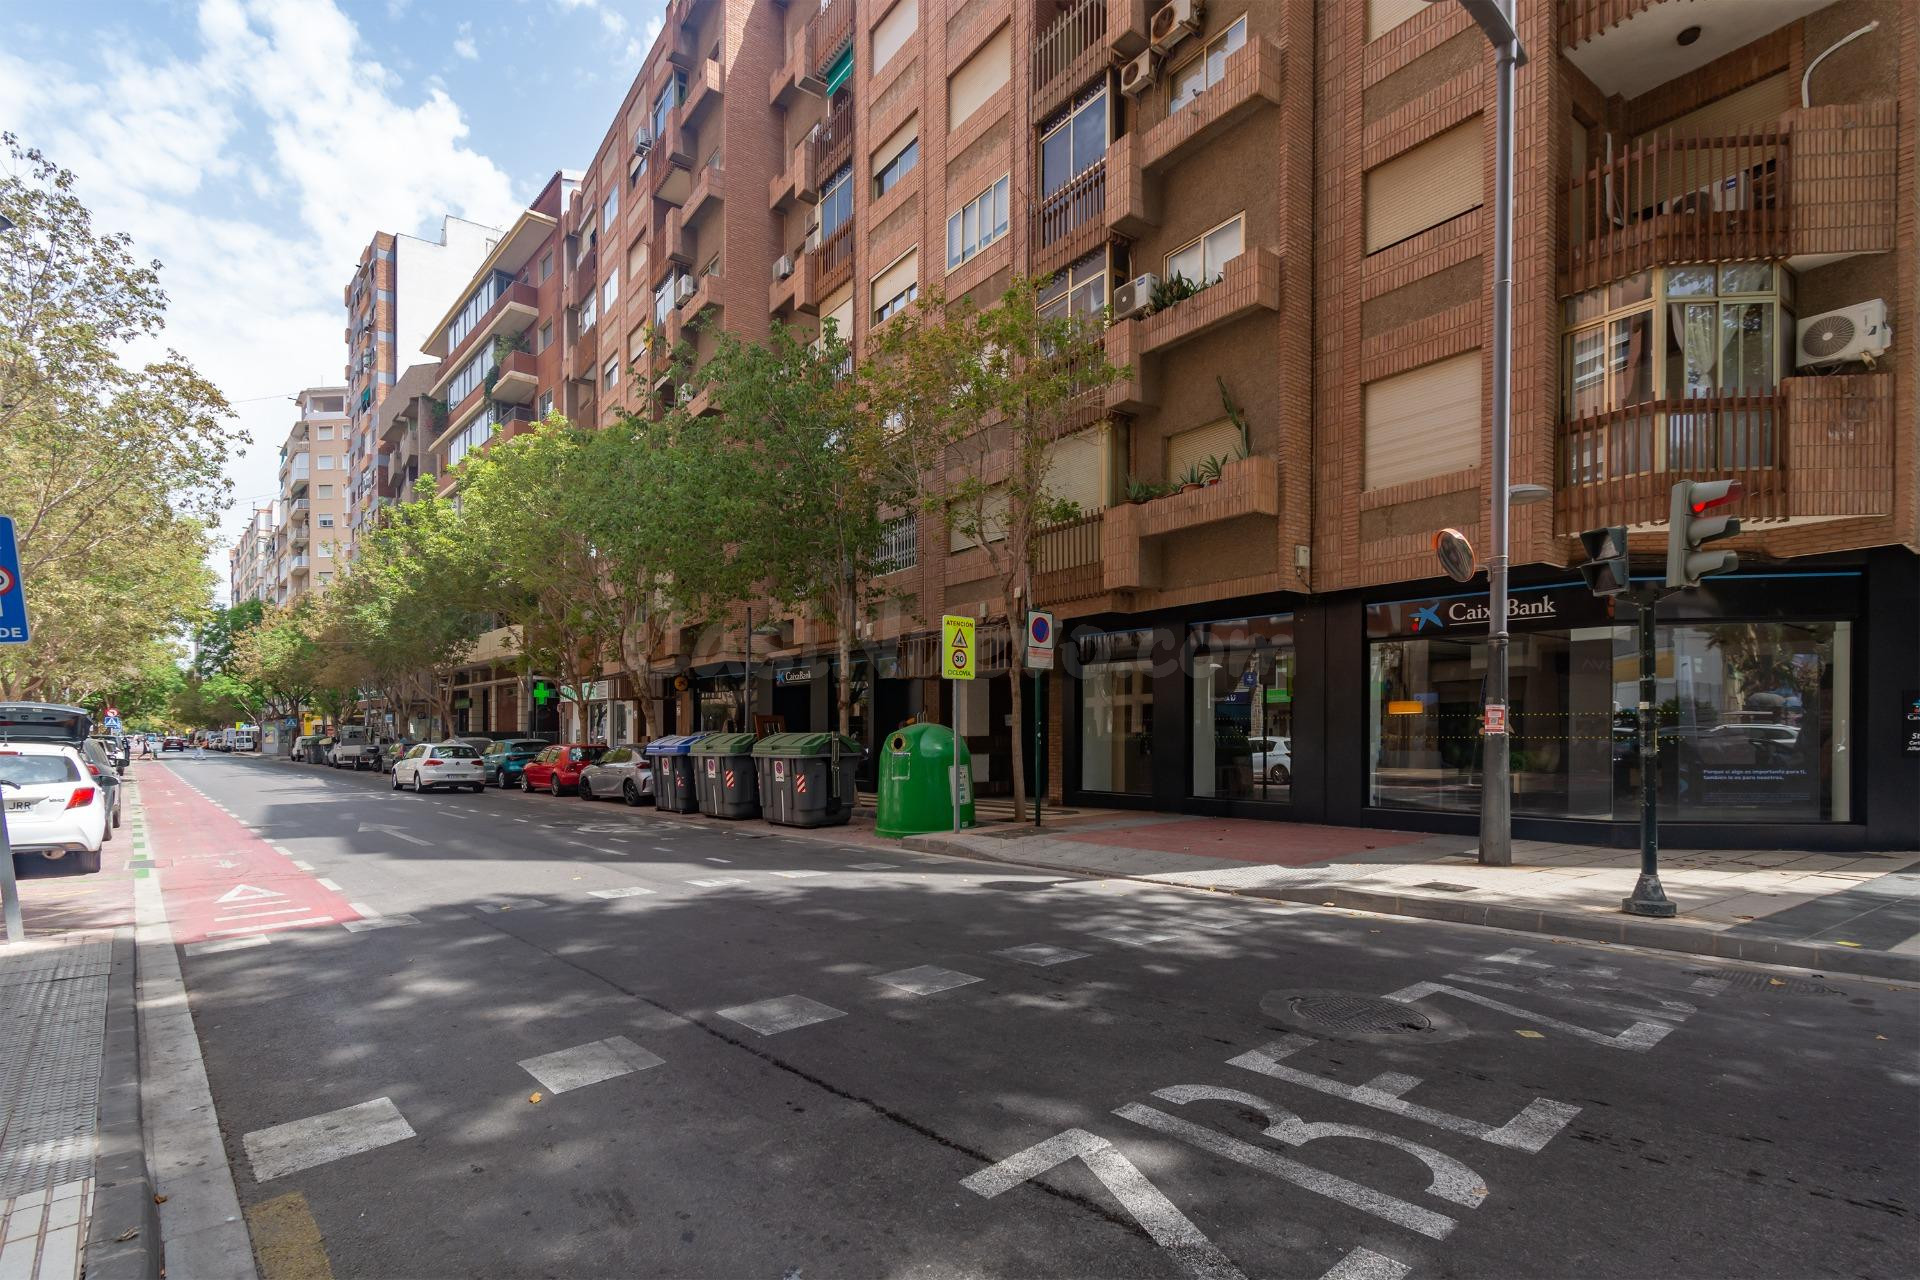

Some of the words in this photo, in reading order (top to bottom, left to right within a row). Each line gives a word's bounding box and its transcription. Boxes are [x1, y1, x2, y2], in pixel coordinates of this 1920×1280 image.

[1449, 595, 1557, 621] CaixBank
[955, 655, 964, 663] 30
[9, 801, 32, 810] JRR
[959, 1033, 1583, 1280] ZBE
